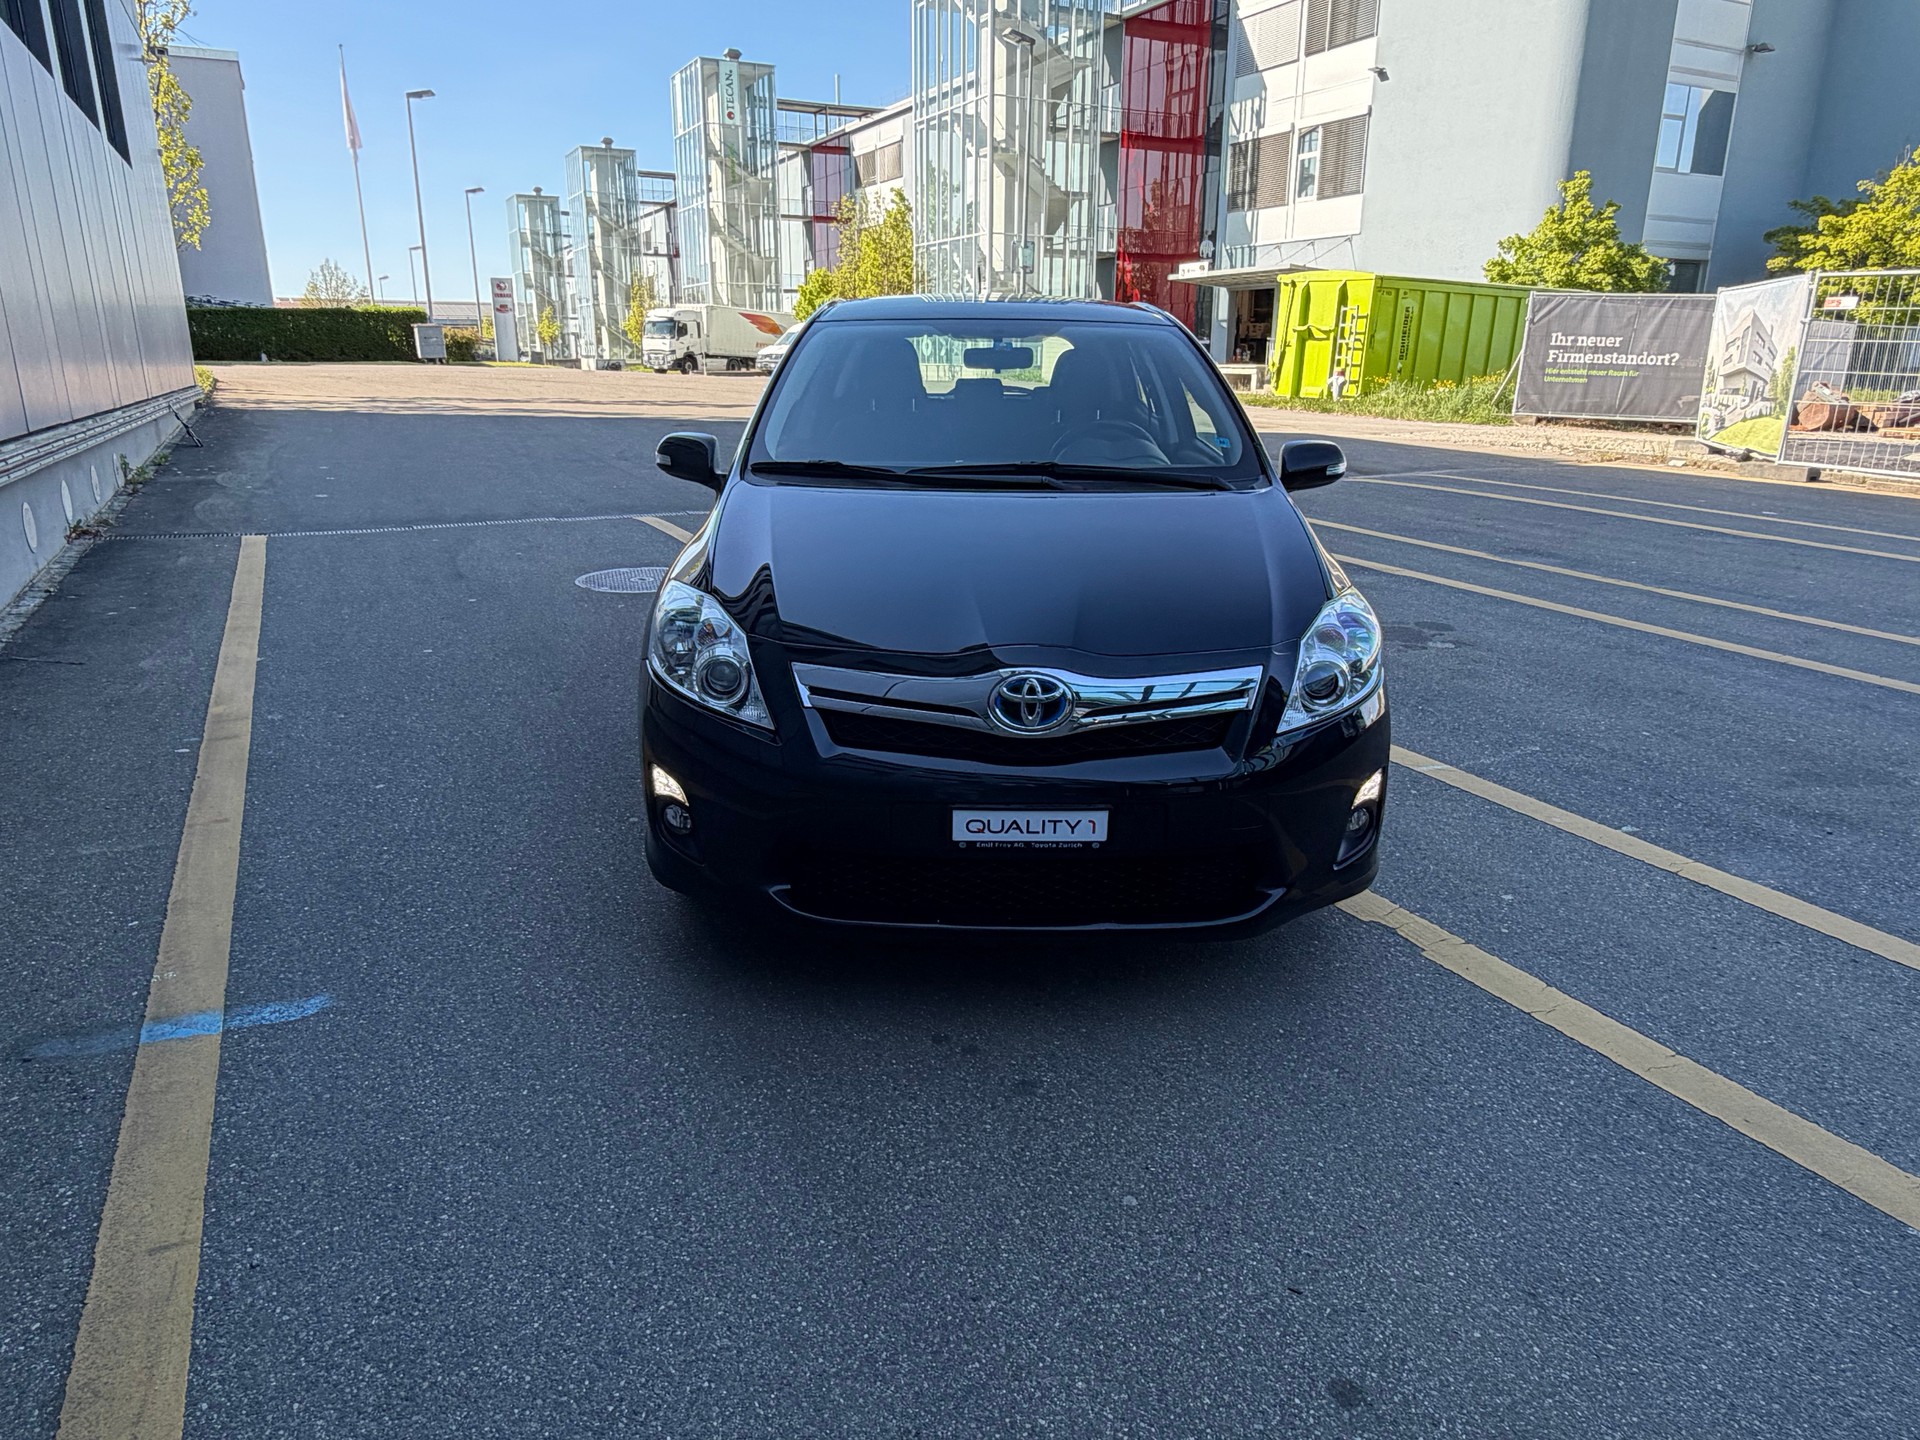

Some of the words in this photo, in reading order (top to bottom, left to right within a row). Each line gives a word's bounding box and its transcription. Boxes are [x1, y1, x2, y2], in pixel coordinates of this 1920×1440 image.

[1550, 332, 1575, 346] Ihr
[1577, 336, 1623, 347] neuer
[1547, 350, 1680, 366] Firmenstandort?
[1544, 376, 1588, 384] Unternehmen
[965, 819, 1082, 834] QUALITY
[1088, 820, 1096, 834] 1
